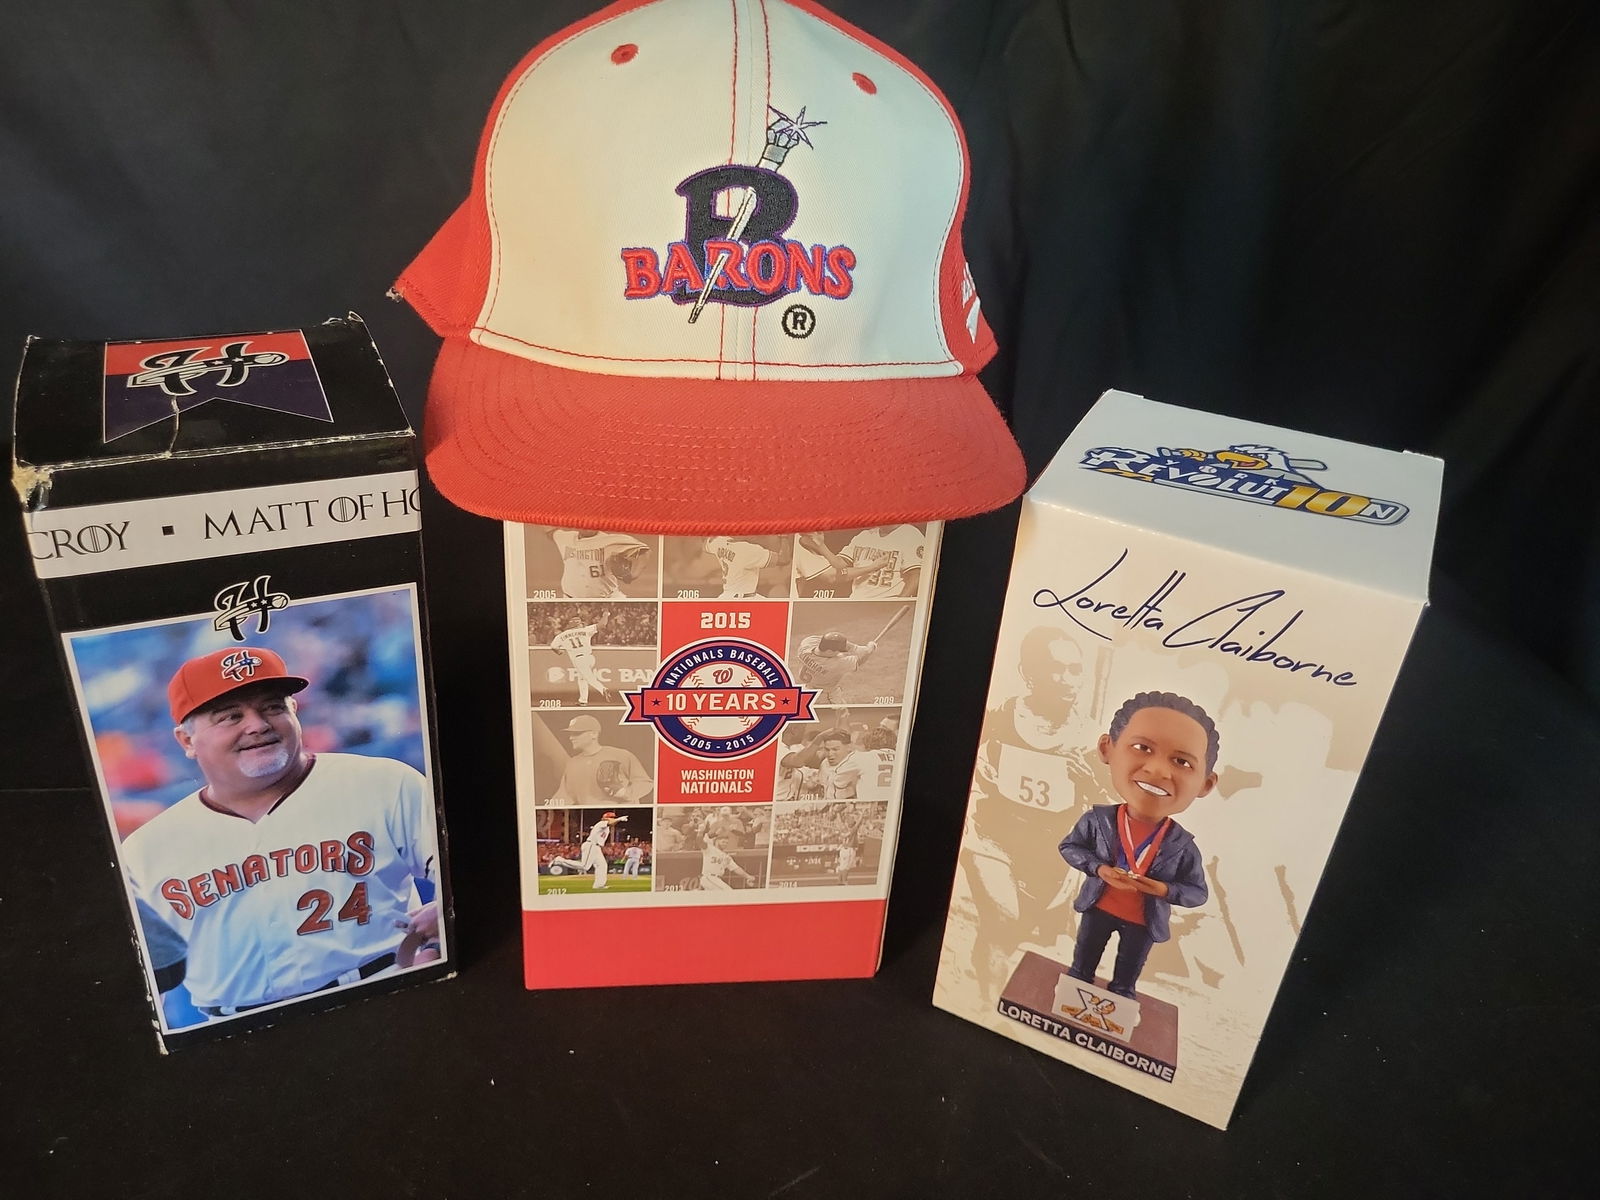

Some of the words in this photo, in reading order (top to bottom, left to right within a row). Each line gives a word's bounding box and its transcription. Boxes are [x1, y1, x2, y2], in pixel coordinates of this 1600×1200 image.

[621, 239, 857, 299] BARONS
[204, 500, 319, 540] MATT
[327, 493, 373, 524] OF
[533, 590, 557, 599] 2005
[677, 589, 700, 599] 2006
[813, 589, 835, 599] 2007
[700, 612, 751, 629] 2015
[1032, 547, 1186, 642] Loretta
[1162, 589, 1358, 687] Claiborne
[568, 637, 584, 649] 11
[664, 648, 724, 686] NATIONALS
[729, 649, 780, 686] BASEBALL
[712, 667, 734, 684] W
[539, 699, 562, 708] 2008
[666, 693, 687, 711] 10
[692, 692, 777, 711] YEARS
[873, 696, 895, 704] 2009
[682, 734, 712, 750] 2005
[726, 734, 755, 750] 2015
[681, 769, 755, 781] WASHINGTON
[681, 781, 753, 794] NATIONALS
[1018, 775, 1050, 807] 53
[161, 831, 375, 920] SENATORS
[296, 882, 373, 936] 24
[999, 1001, 1072, 1041] LORETTA
[1074, 1032, 1175, 1082] CLAIBORNE
